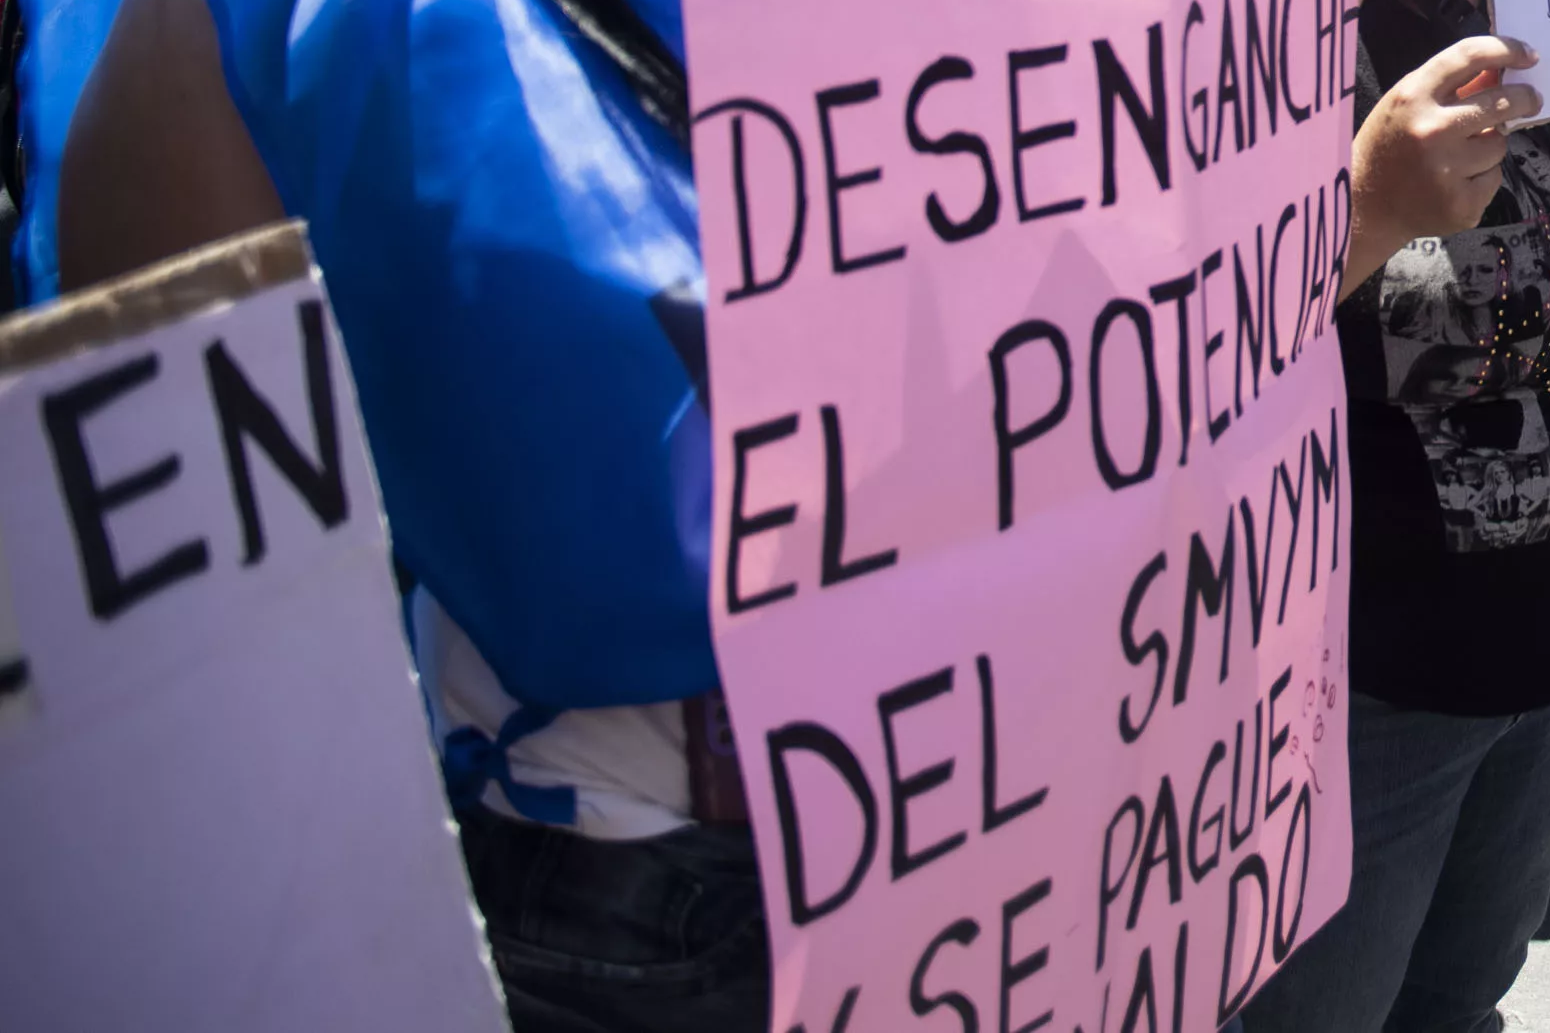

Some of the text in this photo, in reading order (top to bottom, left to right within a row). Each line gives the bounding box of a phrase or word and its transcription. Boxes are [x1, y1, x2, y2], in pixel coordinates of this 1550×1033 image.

[40, 298, 351, 622] EN
[725, 167, 1350, 615] EL POTENCIAR
[765, 407, 1340, 928] DEL SMVYM
[909, 664, 1292, 1033] SE PAGUE
